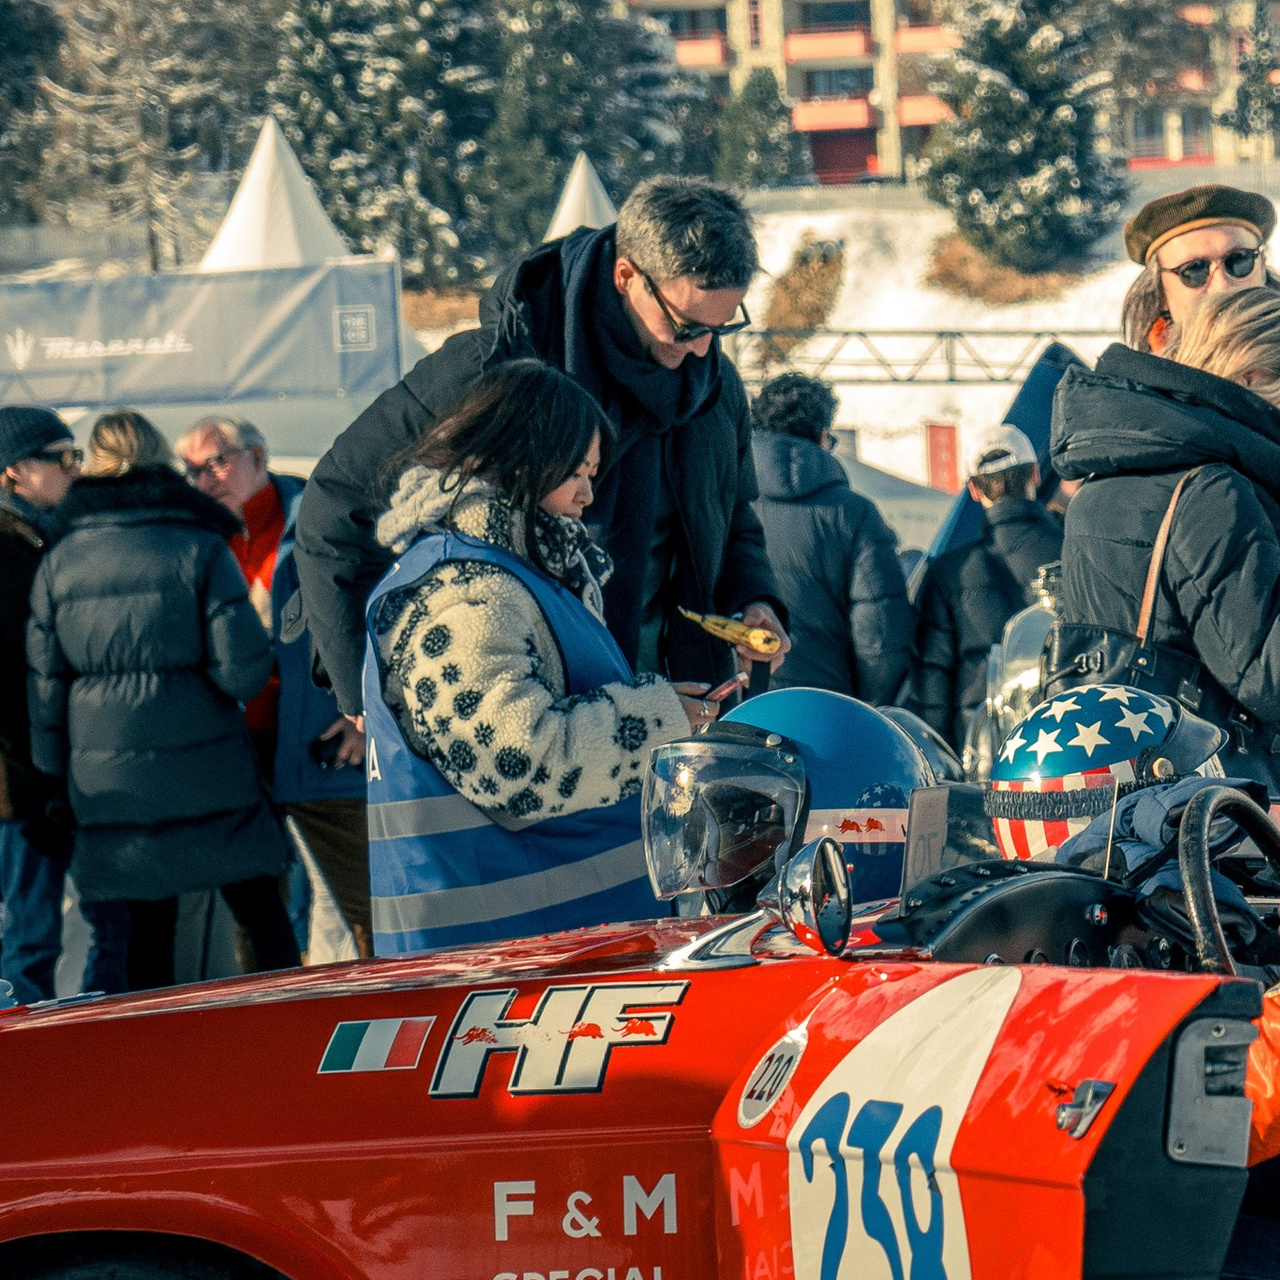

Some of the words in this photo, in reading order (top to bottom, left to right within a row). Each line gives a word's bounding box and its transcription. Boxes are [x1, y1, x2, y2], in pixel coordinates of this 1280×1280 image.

[428, 980, 691, 1100] HF
[744, 1052, 795, 1103] 220
[493, 1179, 537, 1242] F
[561, 1190, 602, 1239] &
[622, 1172, 678, 1236] M
